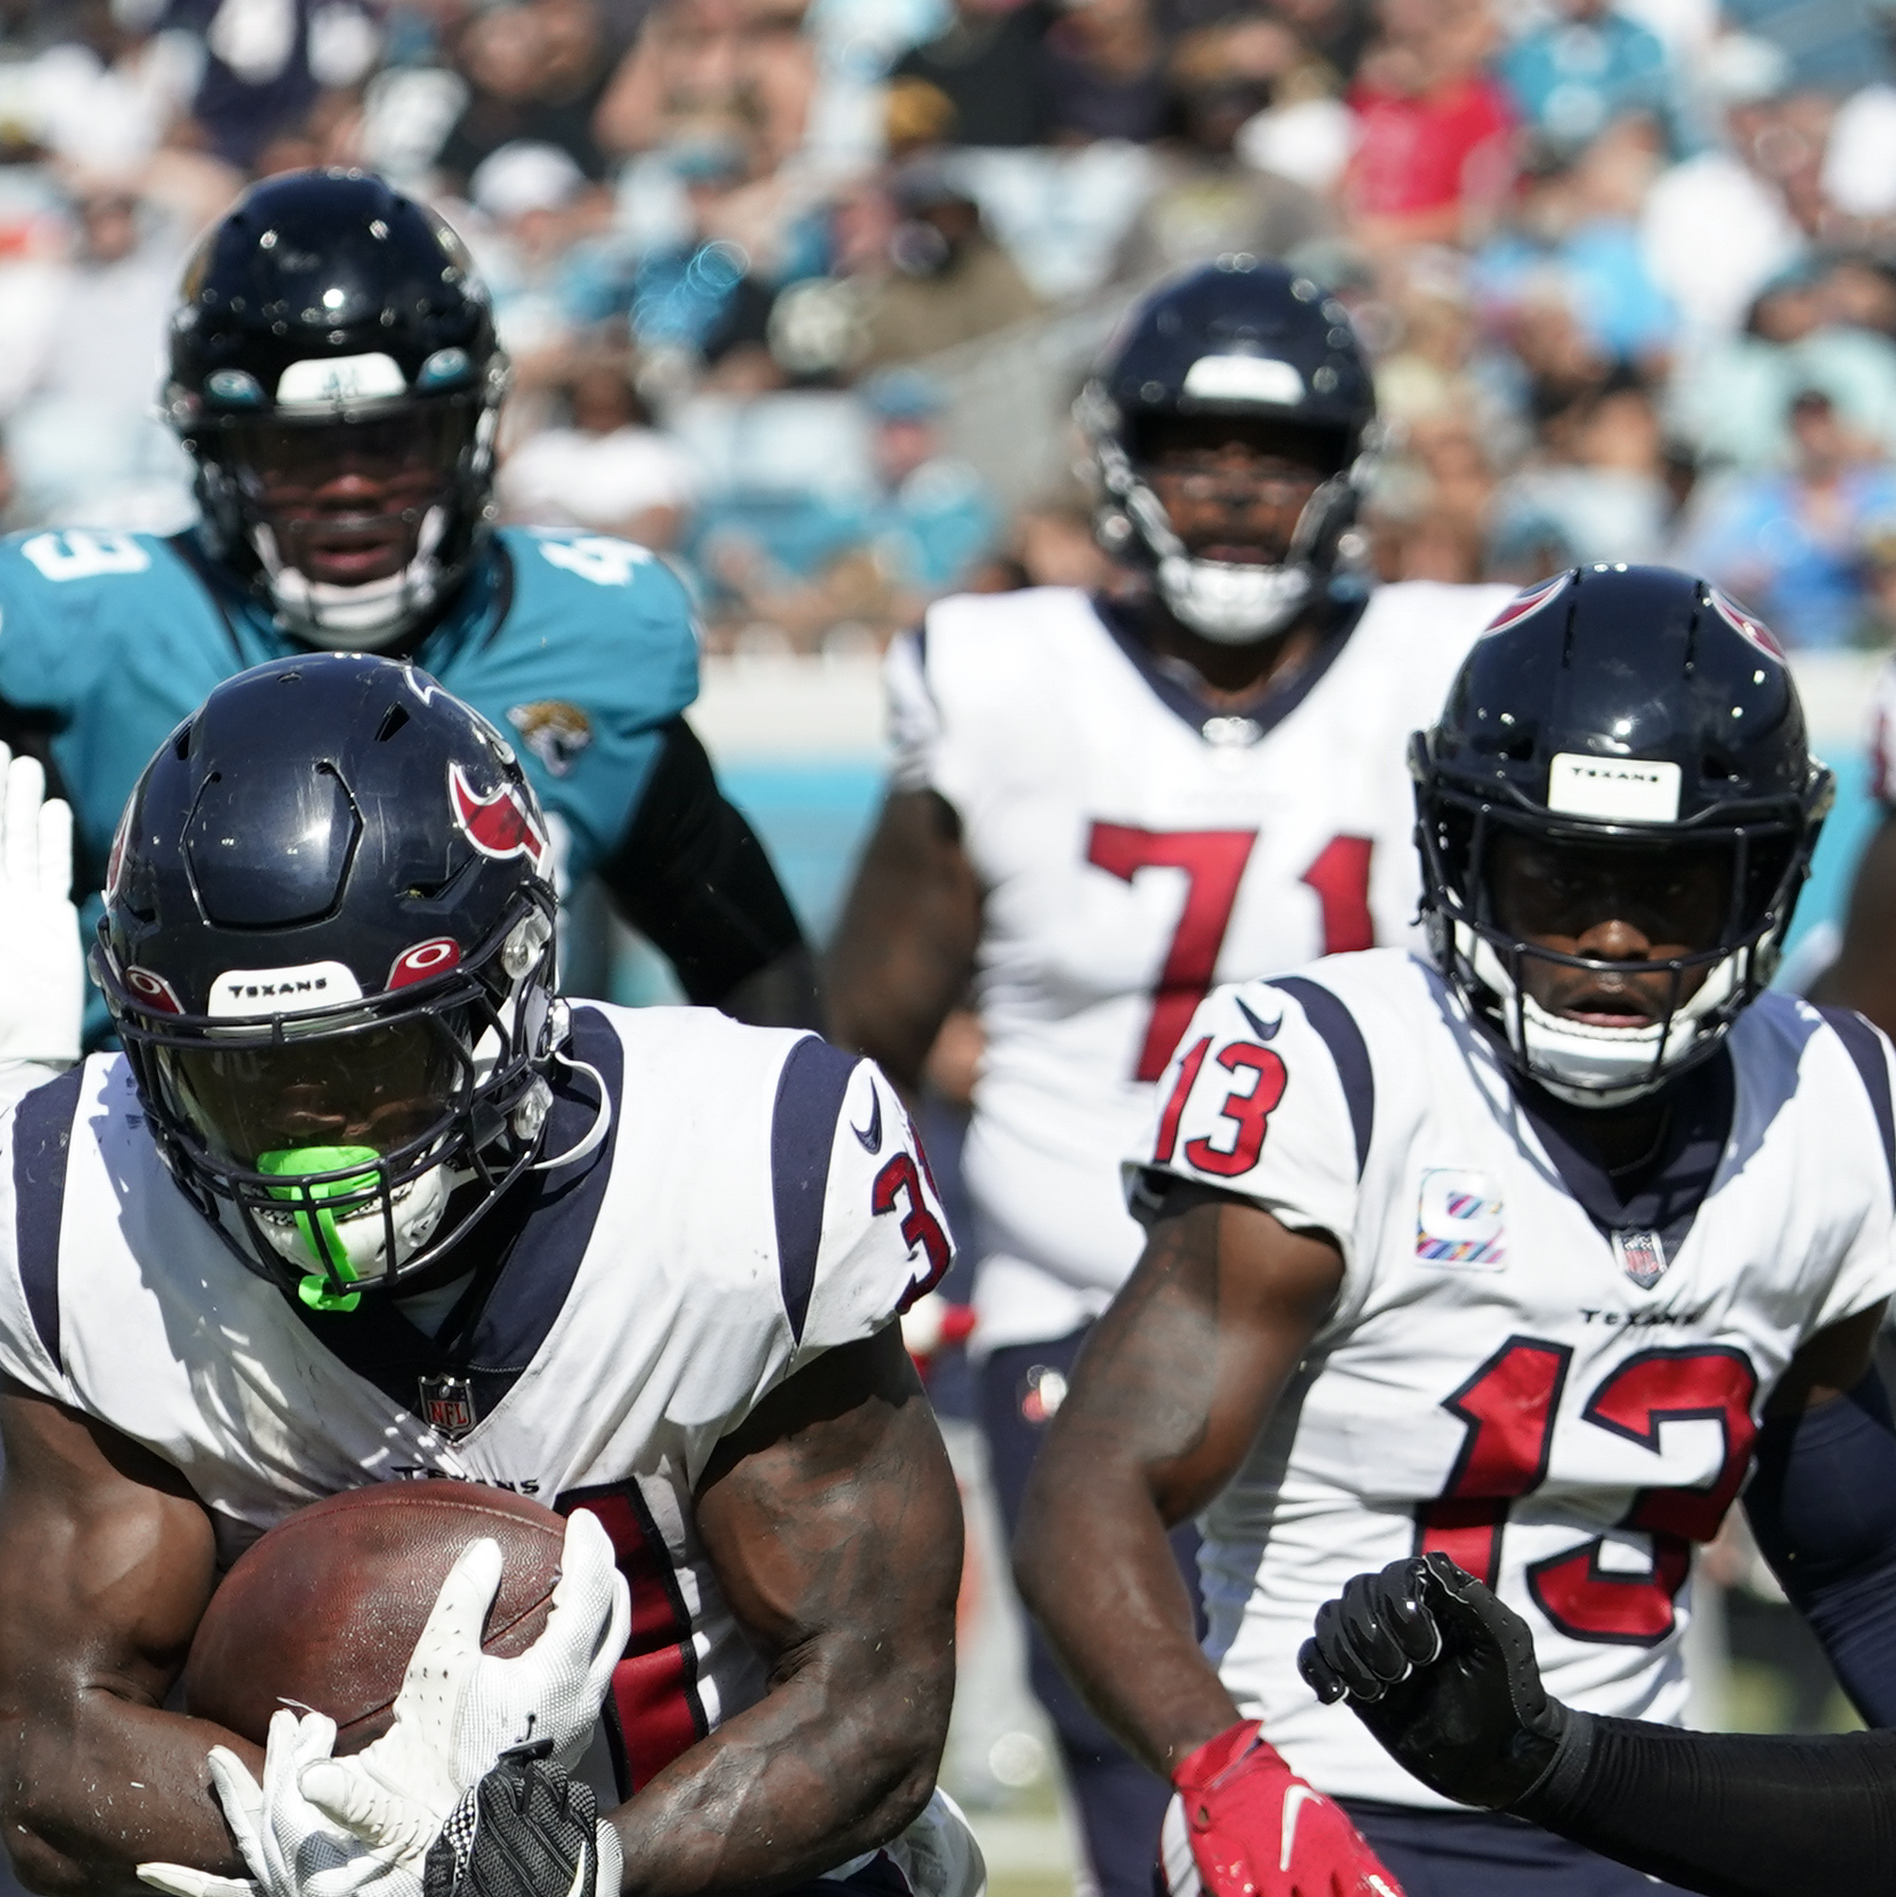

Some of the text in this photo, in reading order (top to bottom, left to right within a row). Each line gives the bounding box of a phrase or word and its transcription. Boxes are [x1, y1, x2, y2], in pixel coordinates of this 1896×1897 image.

[228, 978, 327, 998] TEXANS
[1153, 1035, 1289, 1178] 13
[430, 1401, 467, 1425] NFL
[1413, 1333, 1761, 1648] 13
